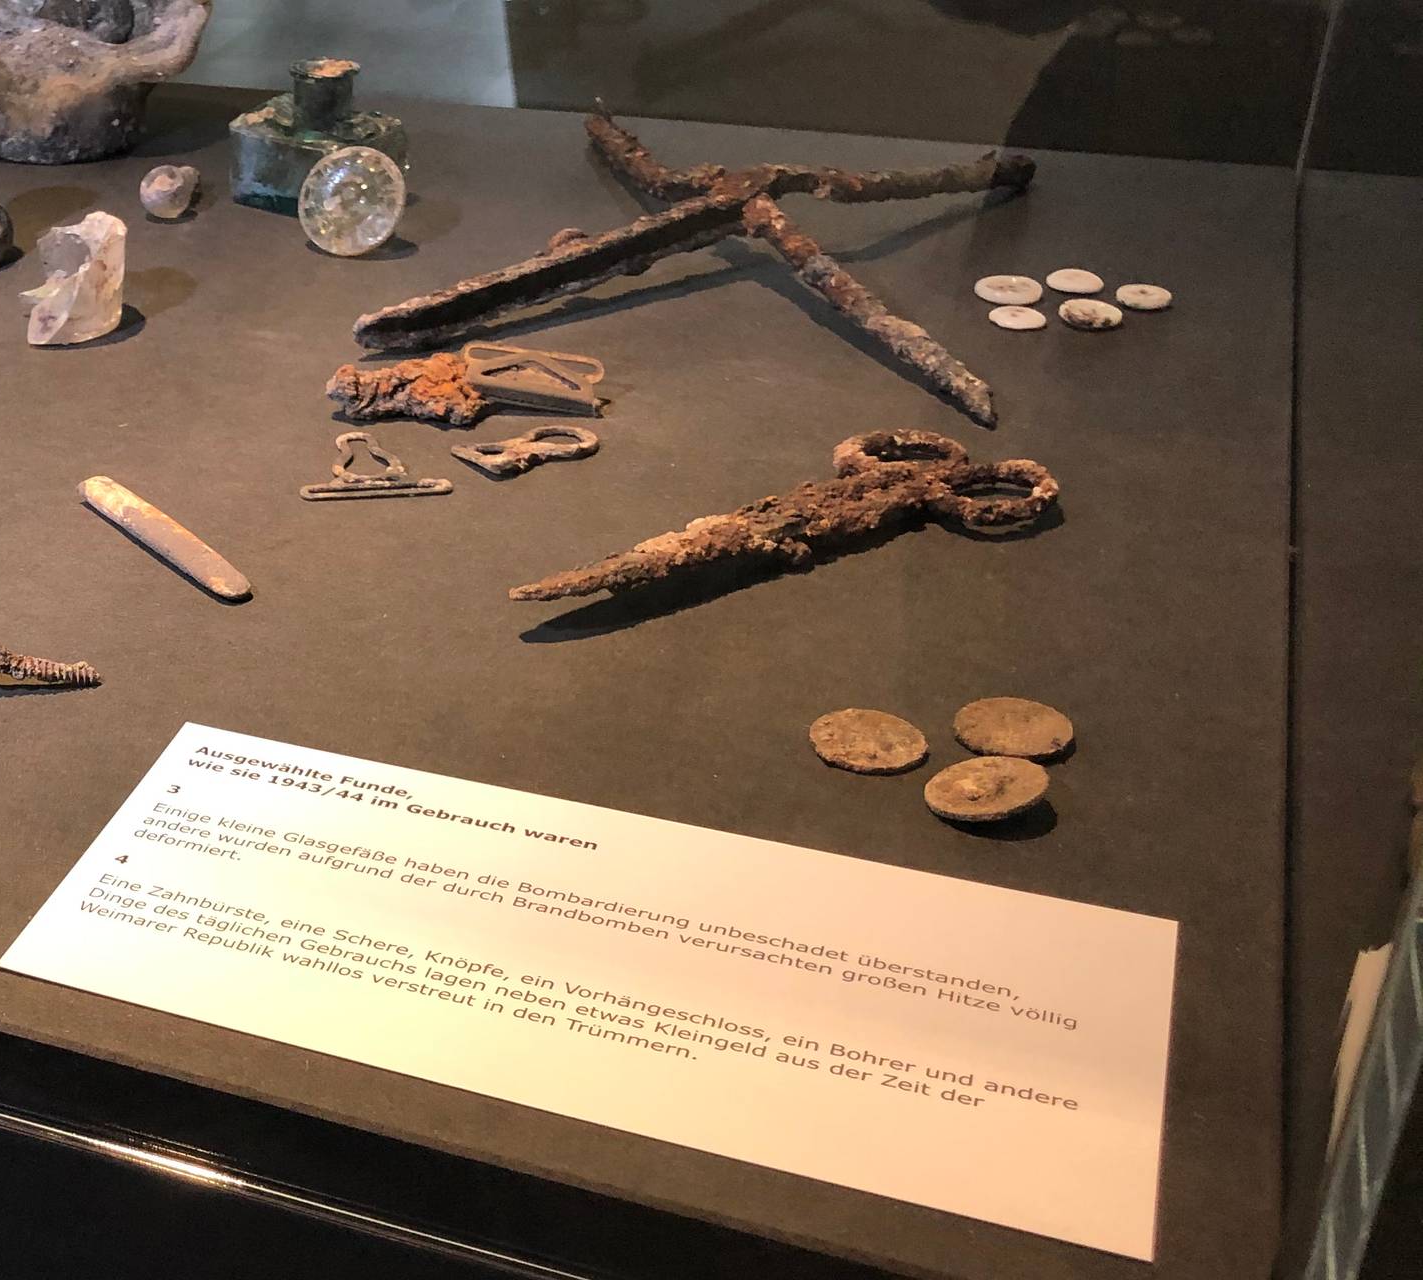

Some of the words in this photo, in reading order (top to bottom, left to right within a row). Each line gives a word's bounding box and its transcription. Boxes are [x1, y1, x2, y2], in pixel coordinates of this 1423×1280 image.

[165, 784, 181, 794] 3
[188, 758, 224, 773] wie
[230, 767, 261, 781] sie
[267, 775, 364, 802] 1943/44
[370, 796, 399, 810] im
[406, 804, 516, 834] Gebrauch
[524, 828, 599, 851] waren
[195, 746, 333, 782] Ausgewählte
[339, 776, 413, 800] Funde,
[114, 854, 129, 864] 4
[134, 827, 241, 861] deformiert.
[153, 802, 211, 823] Einige
[218, 817, 276, 838] kleine
[283, 832, 397, 865] Glasgefäße
[404, 857, 469, 880] haben
[477, 874, 510, 889] die
[517, 882, 689, 930] Bombardierung
[699, 922, 849, 962] unbeschadet
[858, 954, 1020, 1001] überstanden,
[80, 900, 178, 933] Weimarer
[183, 927, 275, 958] Republik
[282, 952, 363, 980] wahllos
[372, 974, 476, 1007] verstreut
[483, 998, 504, 1014] in
[513, 1007, 556, 1027] den
[565, 1018, 697, 1061] Trümmern.
[143, 813, 211, 838] andere
[218, 833, 291, 857] wurden
[298, 851, 394, 879] aufgrund
[400, 873, 437, 888] der
[443, 882, 503, 904] durch
[512, 897, 669, 940] Brandbomben
[679, 934, 833, 975] verursachten
[842, 969, 927, 996] großen
[938, 988, 1001, 1012] Hitze
[1010, 1005, 1078, 1031] völlig
[88, 887, 147, 910] Dinge
[153, 904, 190, 920] des
[196, 913, 291, 945] täglichen
[300, 939, 417, 974] Gebrauchs
[424, 966, 487, 992] lagen
[494, 986, 566, 1011] neben
[575, 1004, 645, 1029] etwas
[654, 1021, 767, 1058] Kleingeld
[775, 1051, 820, 1070] aus
[829, 1062, 873, 1081] der
[881, 1073, 931, 1096] Zeit
[940, 1089, 986, 1107] der
[98, 873, 142, 892] Eine
[147, 885, 270, 926] Zahnbürste,
[280, 917, 326, 936] eine
[332, 929, 414, 959] Schere,
[424, 950, 509, 981] Knöpfe,
[520, 974, 555, 990] ein
[565, 981, 771, 1042] Vorhängeschloss,
[783, 1034, 819, 1052] ein
[830, 1044, 916, 1073] Bohrer
[926, 1067, 974, 1087] und
[984, 1081, 1078, 1111] andere
